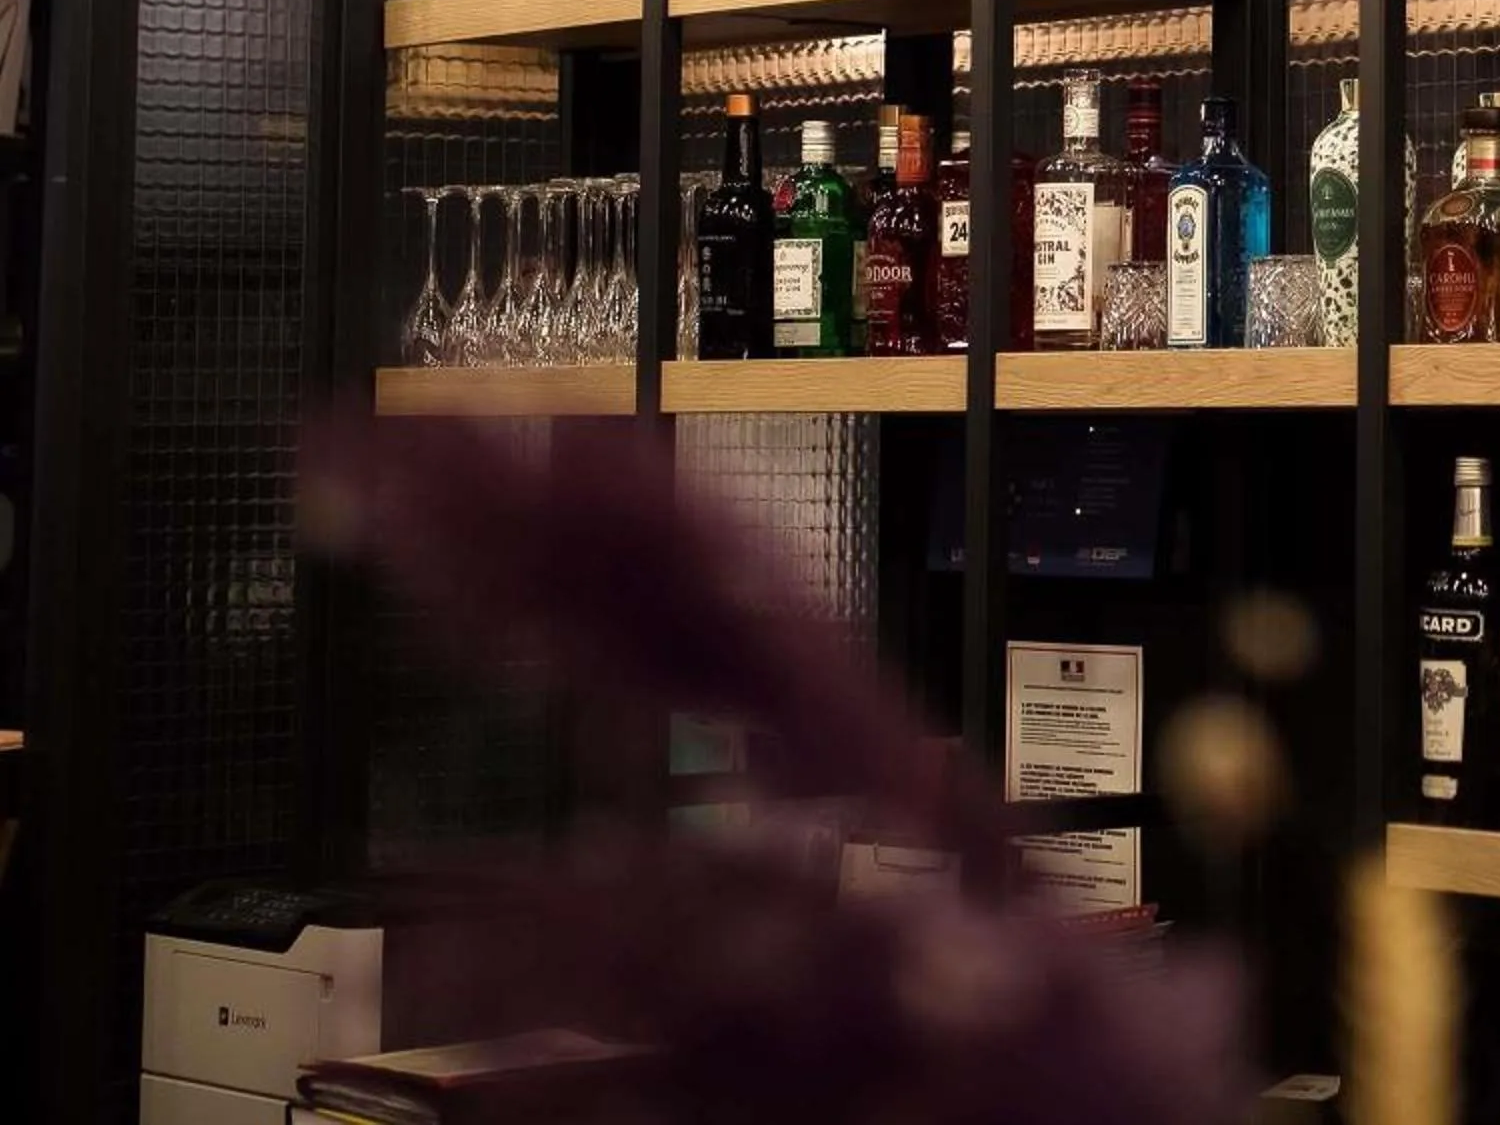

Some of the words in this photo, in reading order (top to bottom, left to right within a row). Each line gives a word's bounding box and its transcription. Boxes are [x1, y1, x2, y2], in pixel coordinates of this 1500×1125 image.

[950, 221, 967, 242] 24
[1034, 240, 1071, 252] STRAL
[1422, 615, 1473, 634] CARD
[231, 1010, 267, 1029] Lexmark
